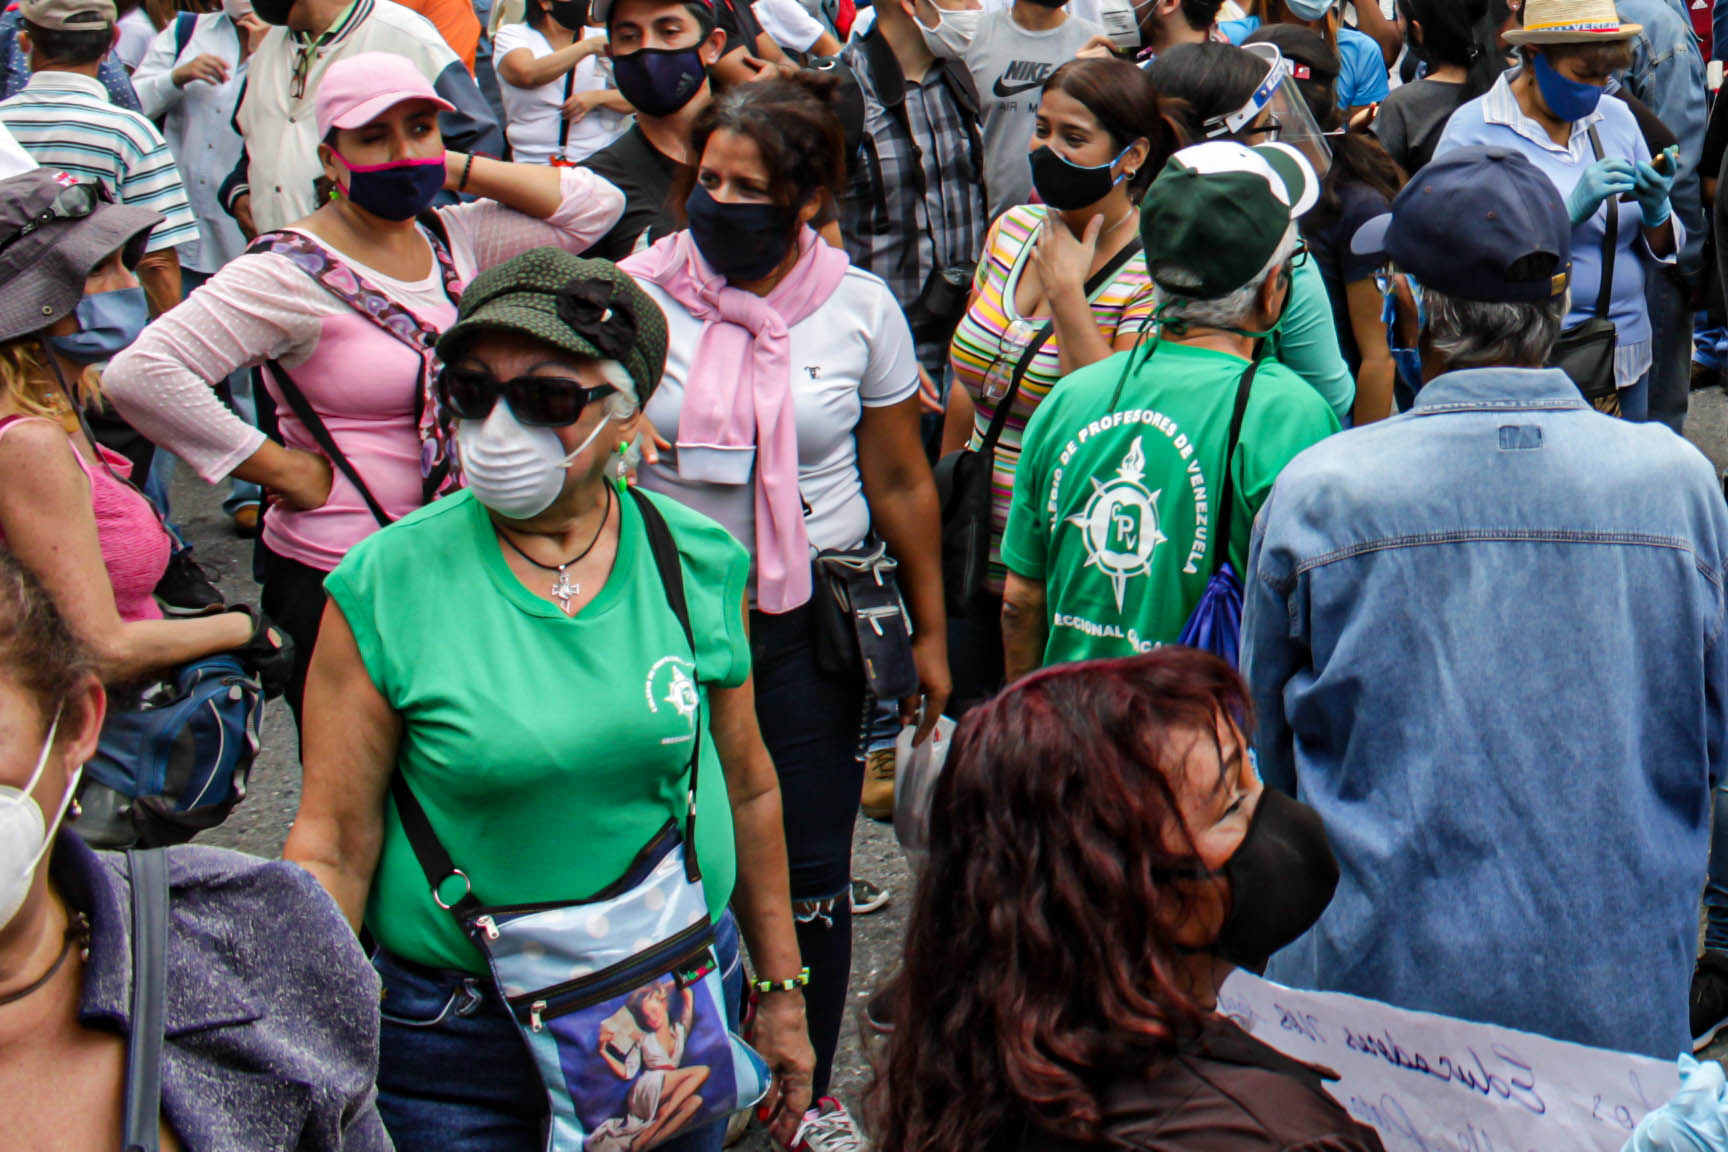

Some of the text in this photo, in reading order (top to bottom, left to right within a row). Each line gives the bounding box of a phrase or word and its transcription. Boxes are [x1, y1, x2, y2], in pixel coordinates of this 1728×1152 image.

[1004, 60, 1052, 83] NIKE
[1077, 408, 1179, 444] PROFESORES
[1060, 440, 1079, 466] DE
[1173, 433, 1195, 460] DE
[1181, 459, 1209, 575] VENEZUELA
